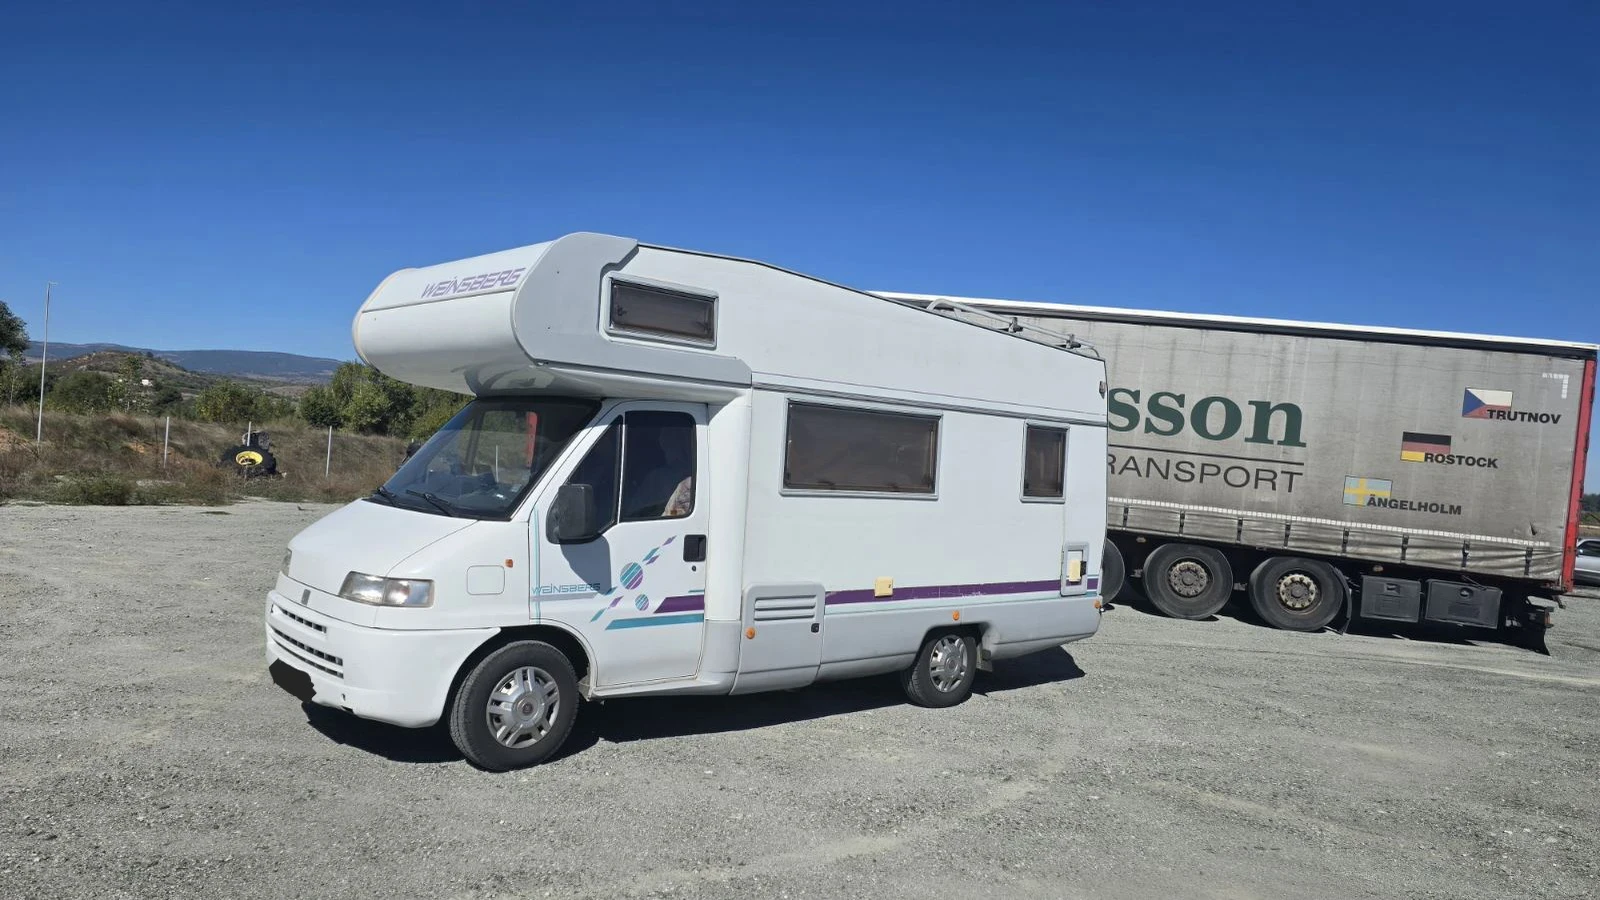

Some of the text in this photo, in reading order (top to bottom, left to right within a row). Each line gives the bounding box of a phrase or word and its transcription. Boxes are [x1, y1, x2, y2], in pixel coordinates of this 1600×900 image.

[420, 267, 526, 298] WEINSBERG
[1108, 387, 1307, 448] sson
[1487, 409, 1562, 425] TRUTNOV
[1424, 452, 1498, 469] ROSTOCK
[1366, 494, 1462, 515] ÄNGELHOLM
